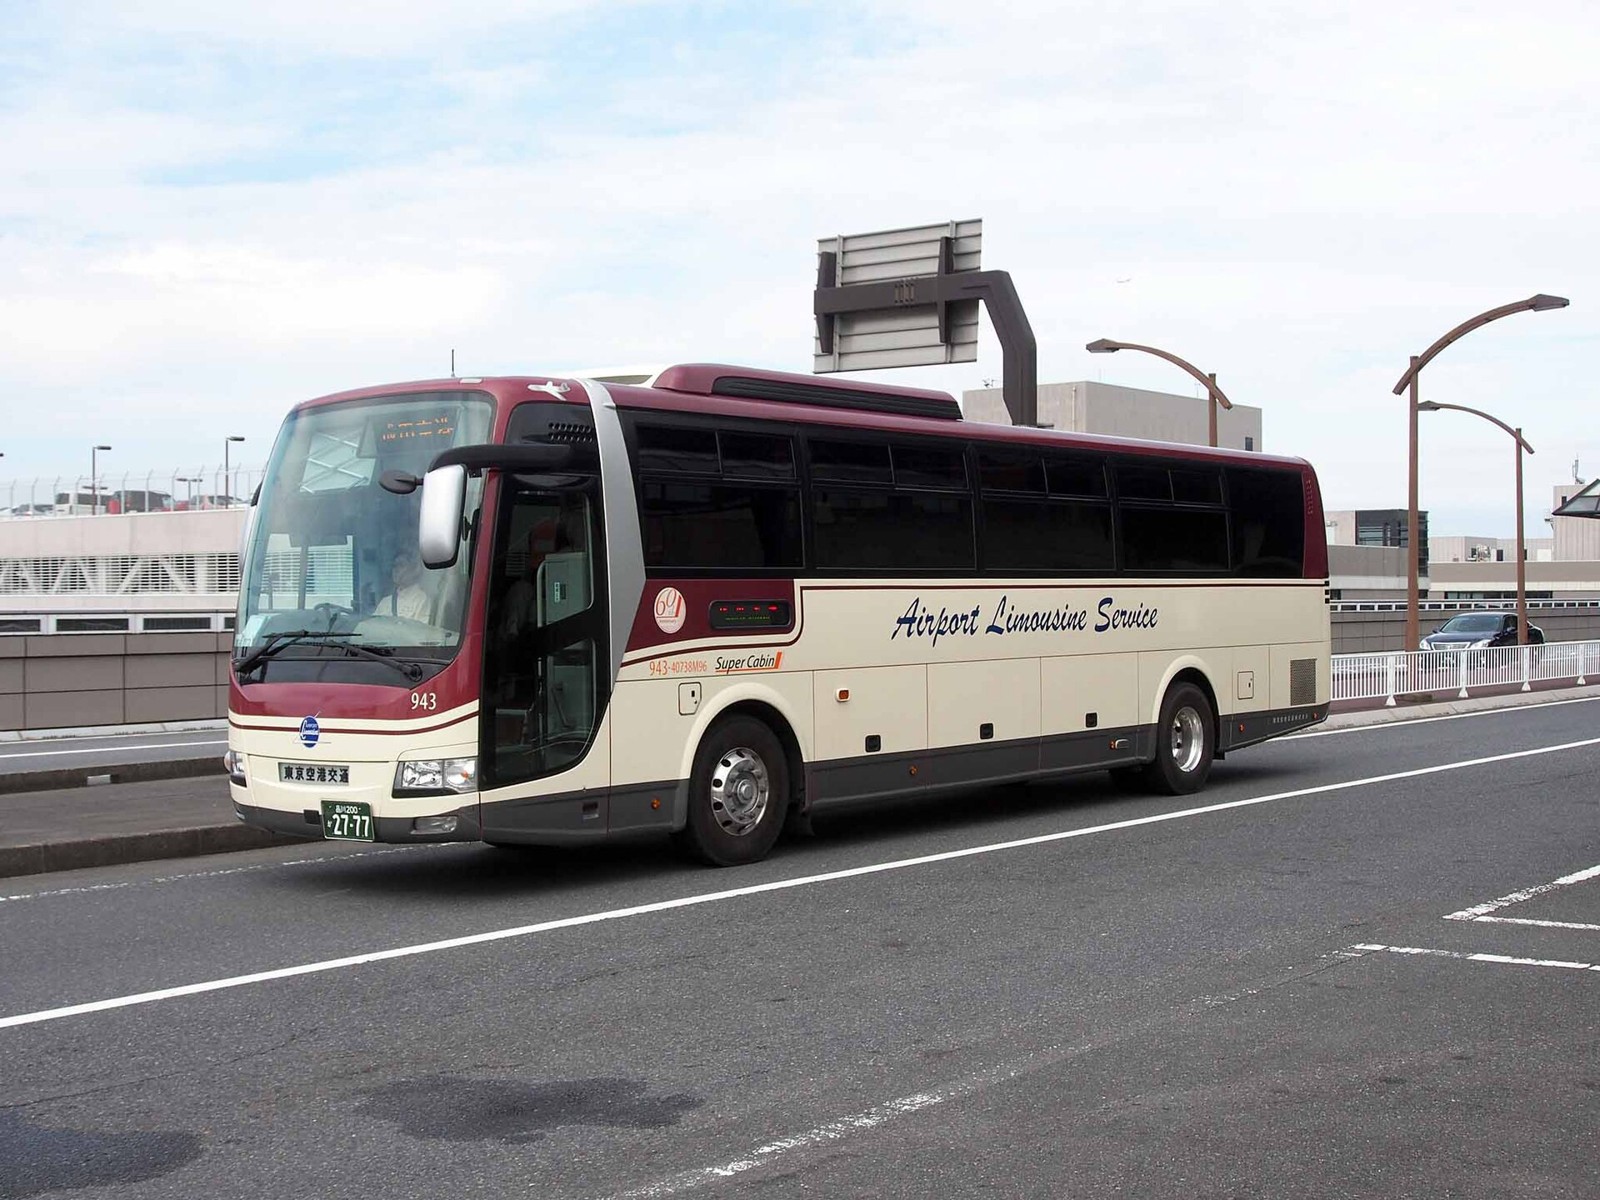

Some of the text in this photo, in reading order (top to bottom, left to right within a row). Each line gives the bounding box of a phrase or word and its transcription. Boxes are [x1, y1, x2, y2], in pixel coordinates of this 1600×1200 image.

[891, 595, 1159, 647] Airport Limousine Service
[715, 654, 775, 674] Super Cabin
[411, 692, 437, 711] 943
[284, 765, 349, 783] 東京空港交通
